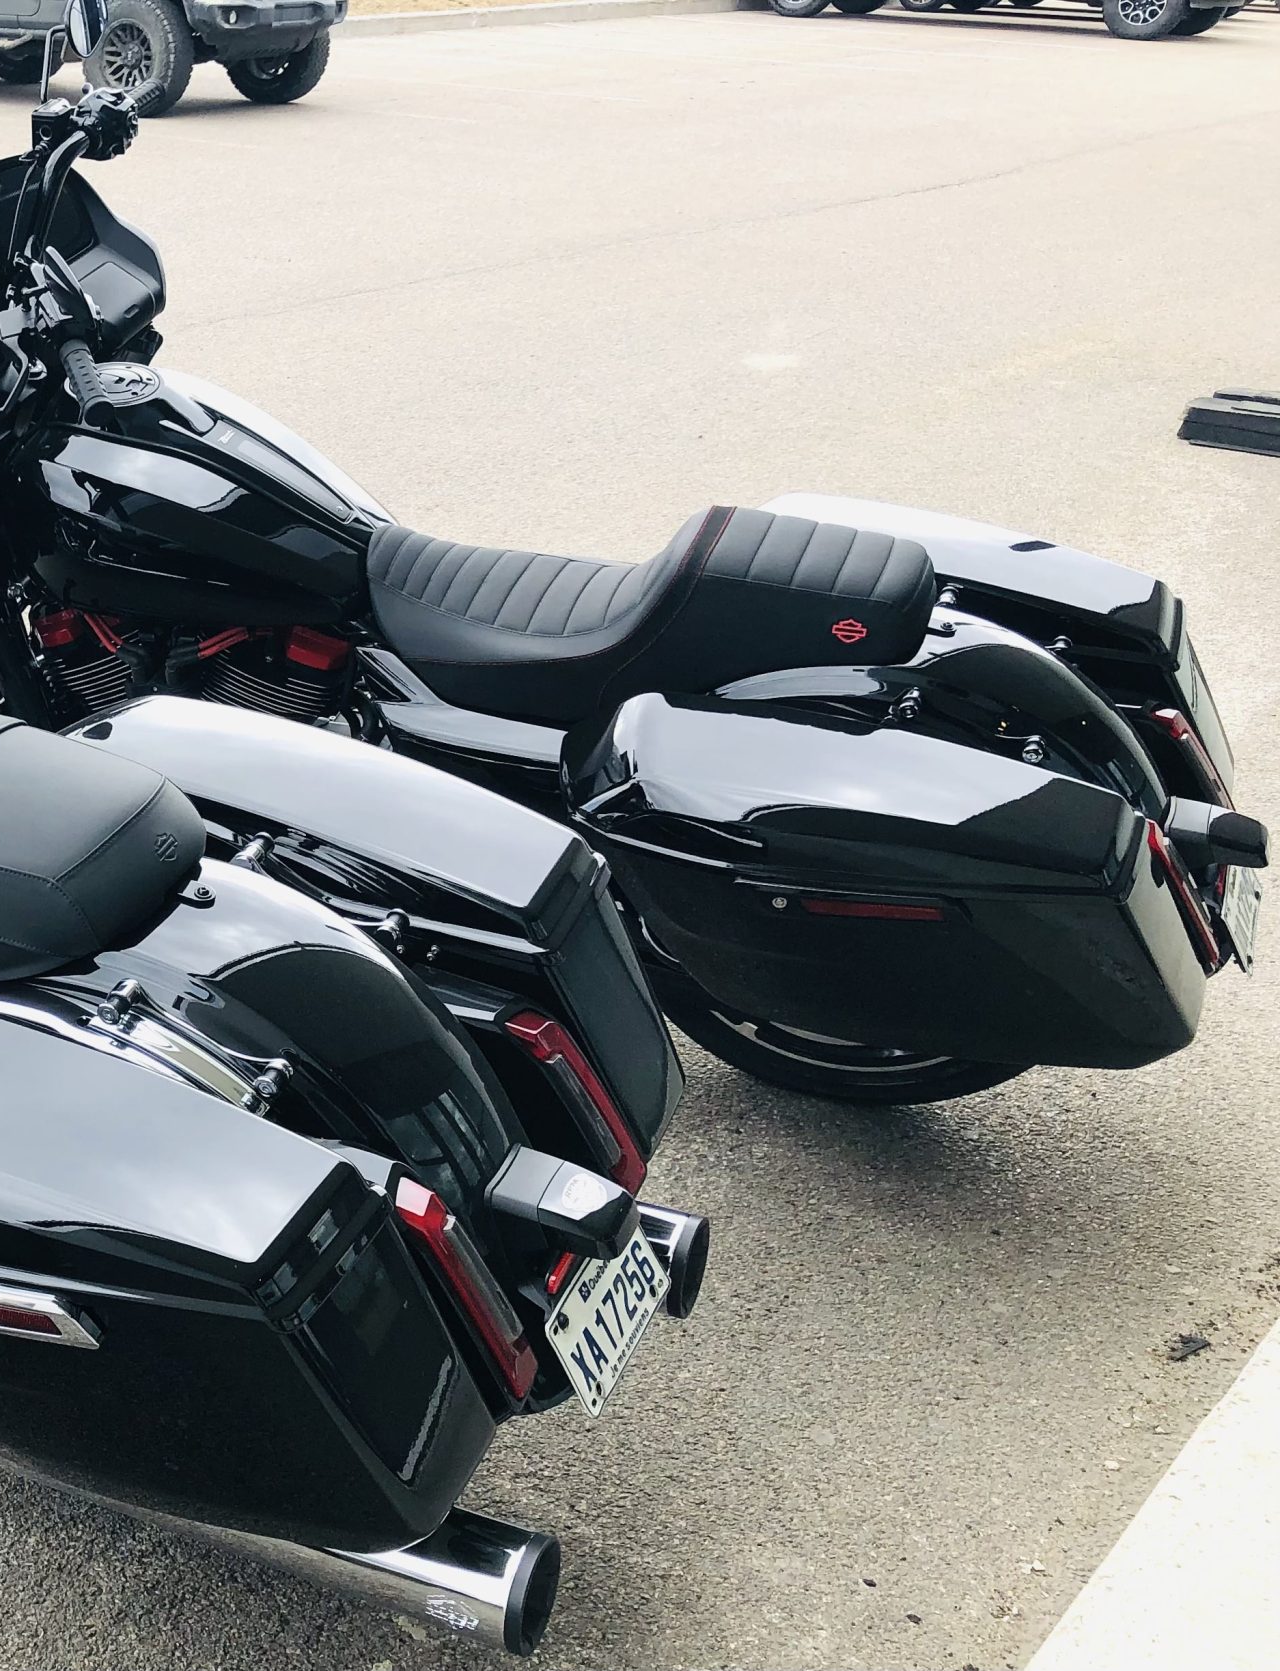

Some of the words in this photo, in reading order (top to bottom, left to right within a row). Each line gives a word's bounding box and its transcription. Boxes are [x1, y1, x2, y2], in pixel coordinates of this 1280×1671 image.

[570, 1240, 655, 1392] XA17256
[610, 1364, 619, 1378] Je
[617, 1349, 627, 1366] me
[625, 1307, 650, 1351] souviens
